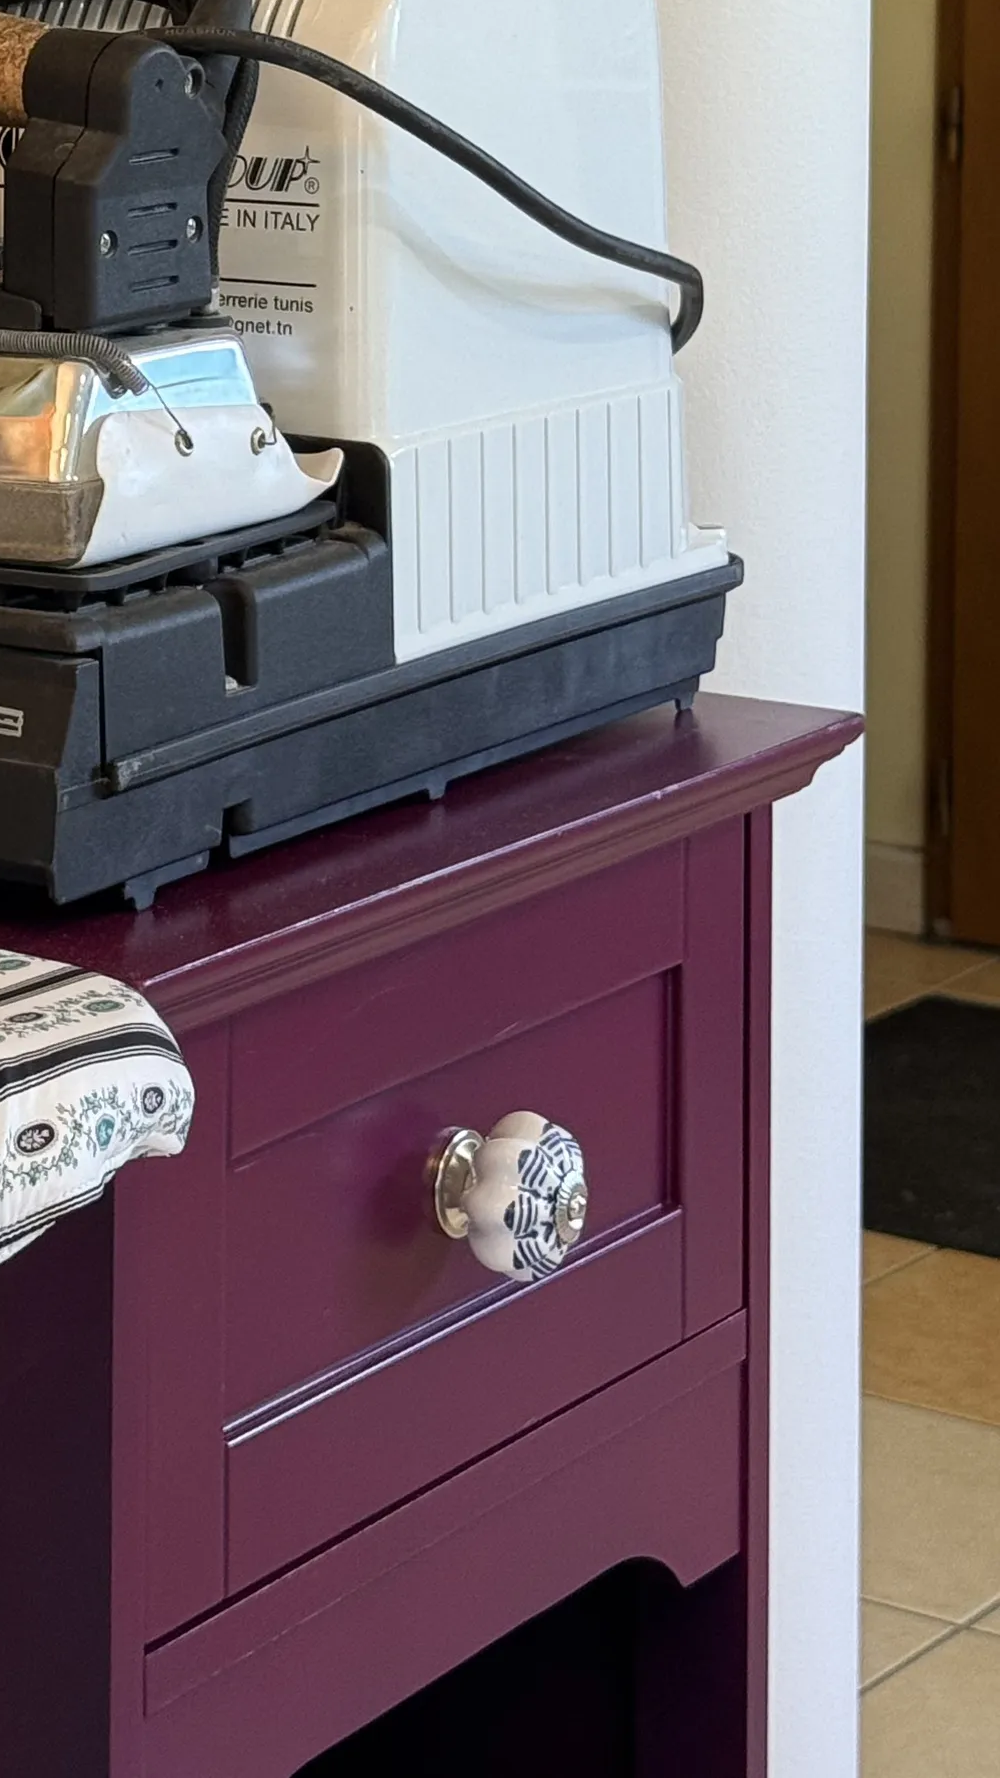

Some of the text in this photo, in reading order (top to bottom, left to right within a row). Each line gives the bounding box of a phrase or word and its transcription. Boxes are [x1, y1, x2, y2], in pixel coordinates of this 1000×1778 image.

[236, 208, 257, 228] IN
[264, 209, 321, 232] ITALY
[219, 292, 314, 313] errerie tunis
